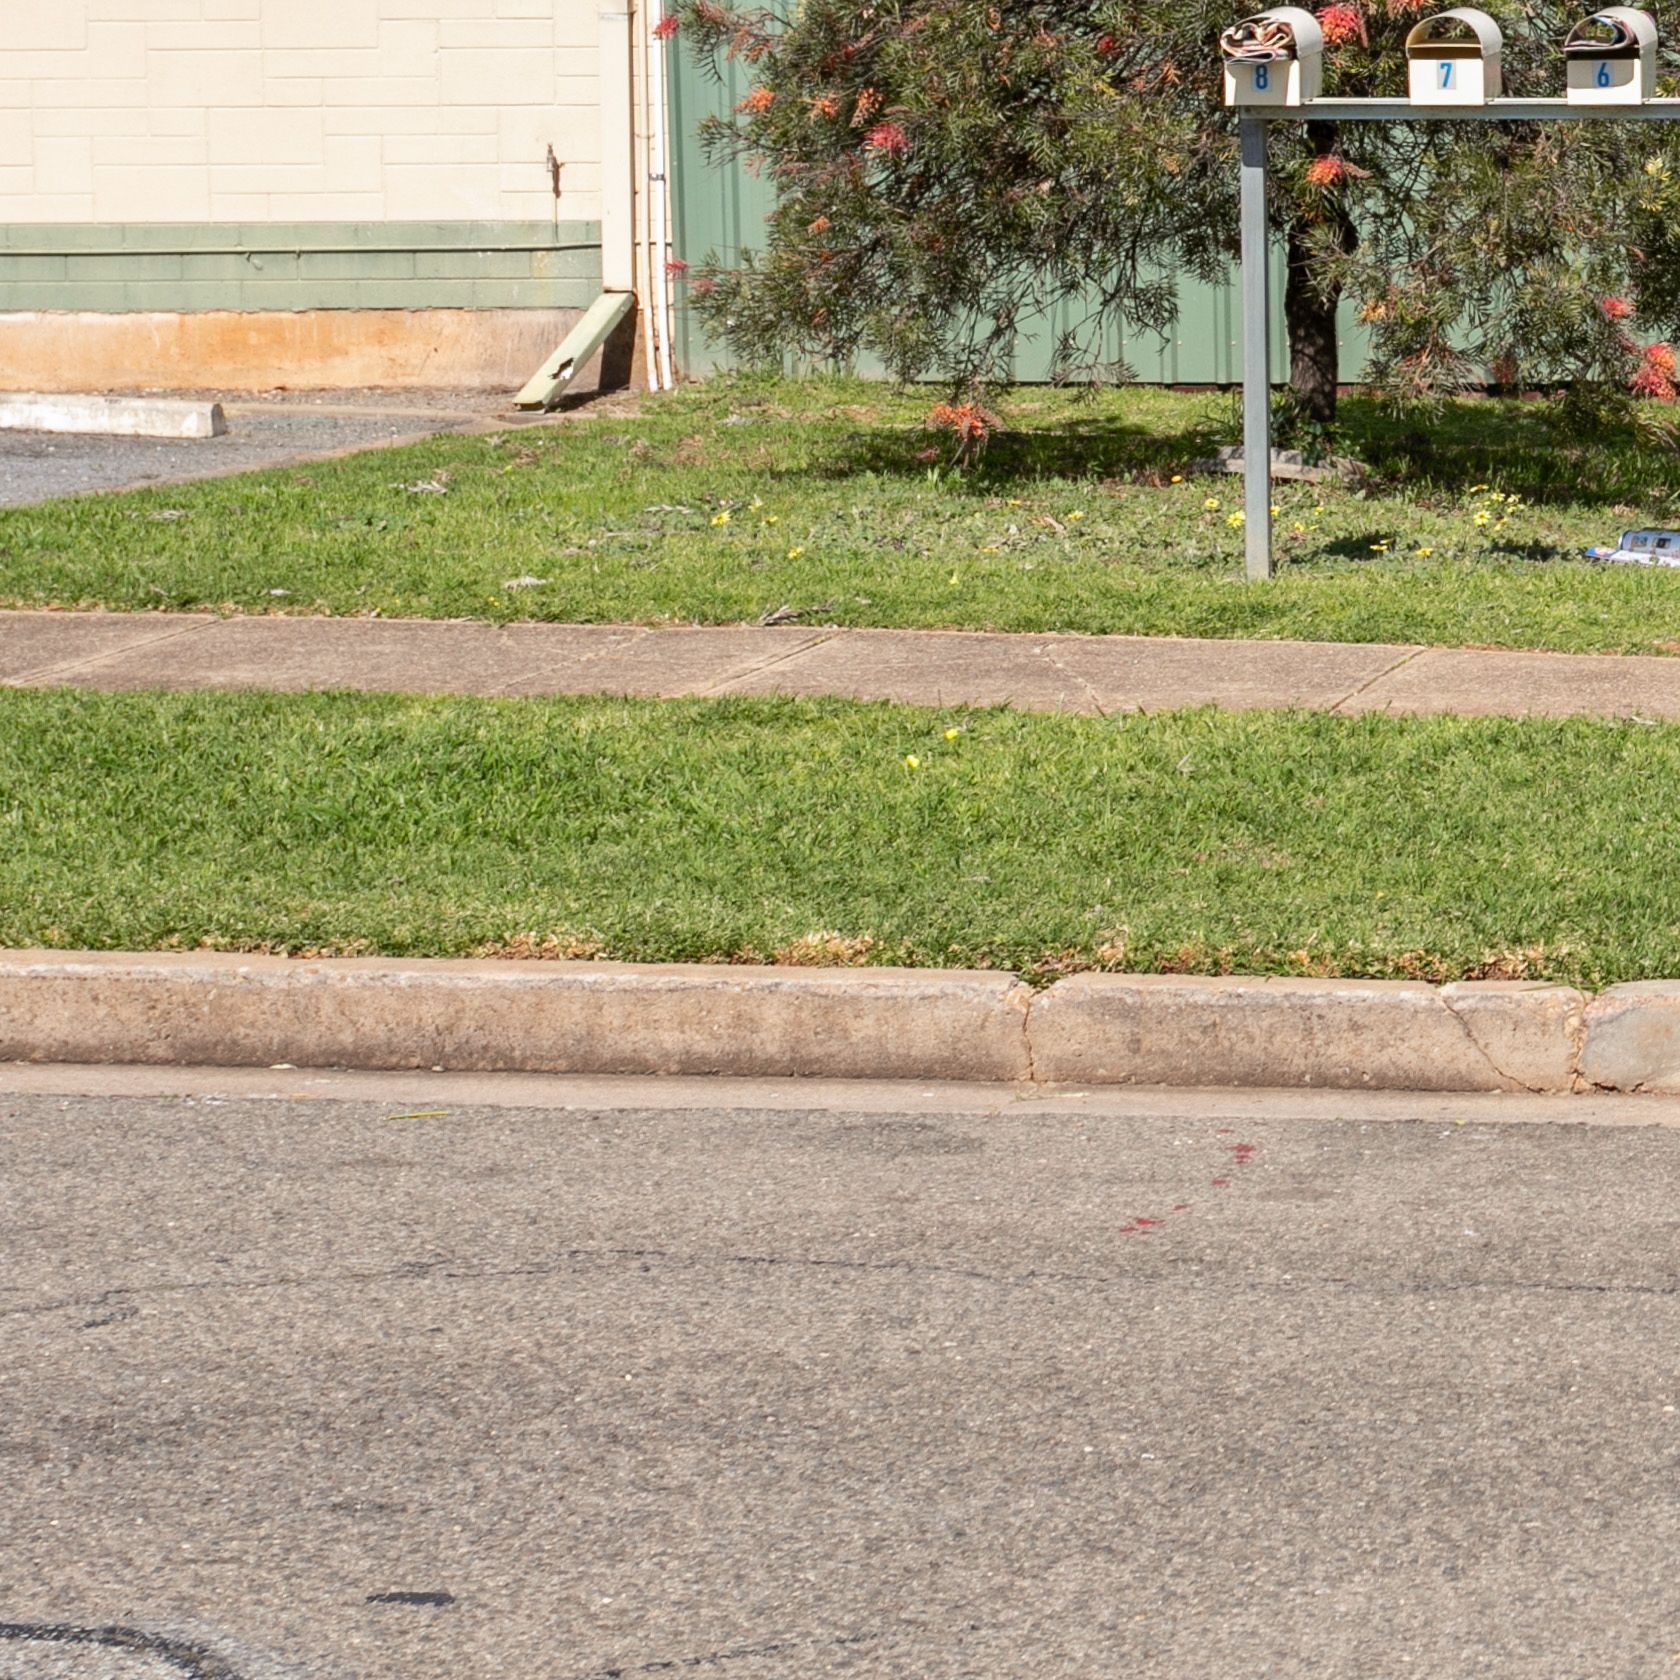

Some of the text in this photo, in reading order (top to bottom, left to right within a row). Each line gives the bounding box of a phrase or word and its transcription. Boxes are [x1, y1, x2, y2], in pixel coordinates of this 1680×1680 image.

[1255, 64, 1268, 90] 8
[1440, 62, 1453, 88] 7
[1597, 62, 1610, 87] 6
